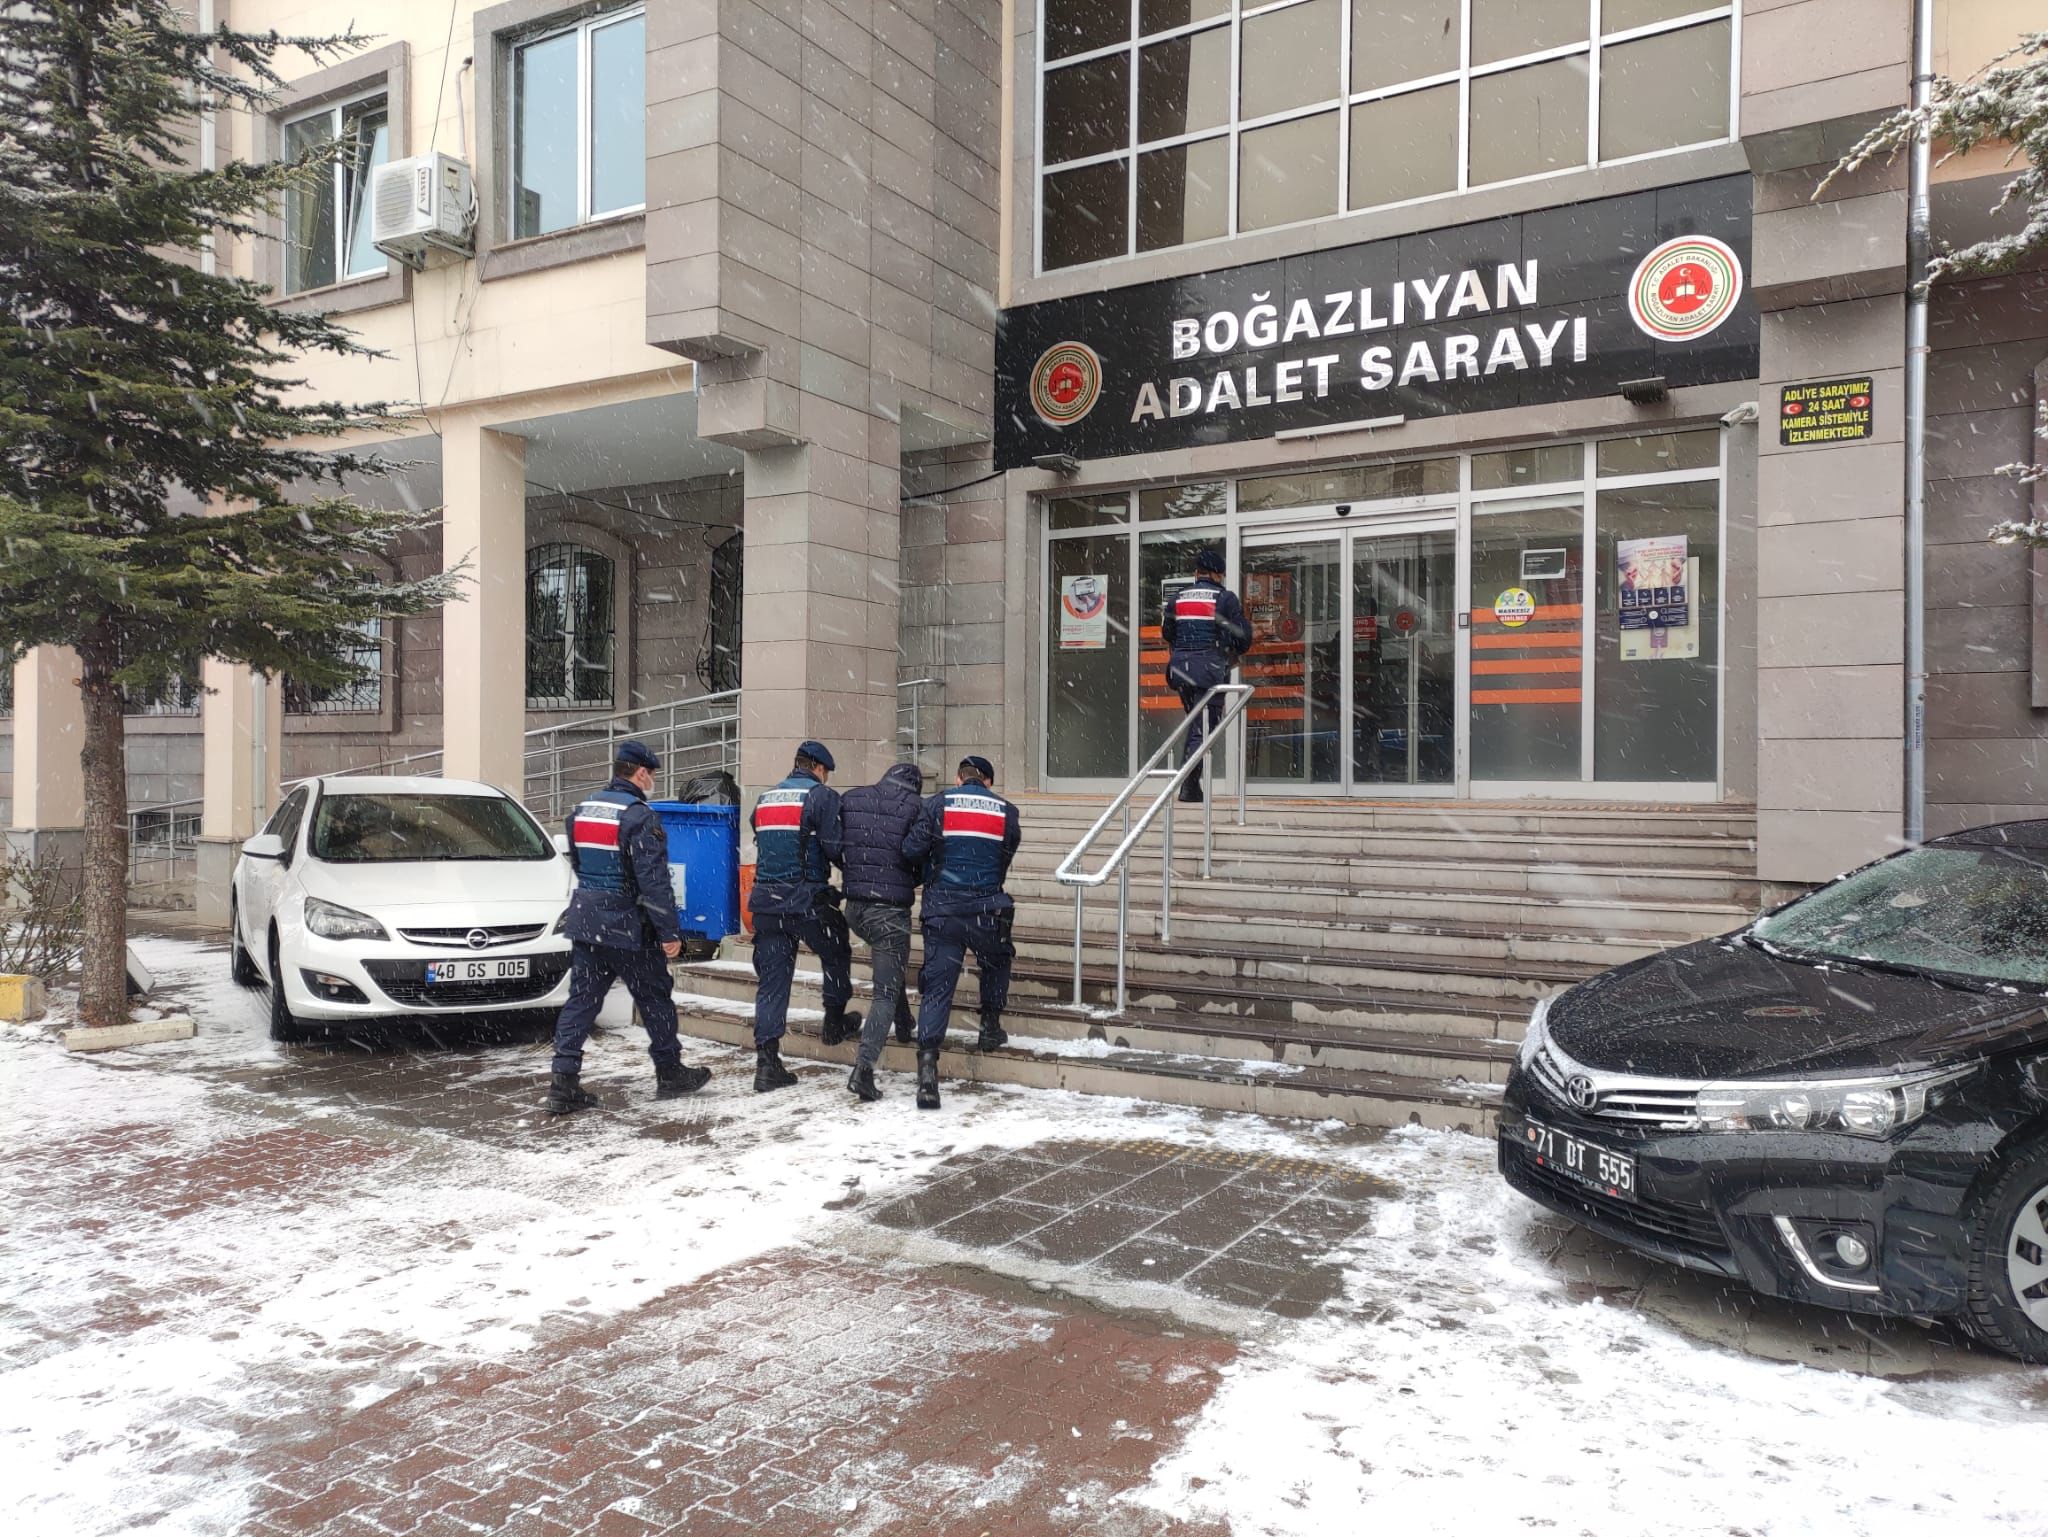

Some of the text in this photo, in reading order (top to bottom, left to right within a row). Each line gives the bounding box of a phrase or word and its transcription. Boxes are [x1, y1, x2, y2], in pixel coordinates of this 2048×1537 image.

[1660, 256, 1684, 276] ADALET
[1173, 258, 1539, 360] BOĞAZLIYAN
[1679, 307, 1706, 322] ADALET
[1131, 316, 1588, 424] ADALET SARAYI
[1784, 382, 1870, 401] ADLİYE SARAYIMIZ
[1808, 398, 1846, 412] 24 SAAT
[1782, 410, 1869, 430] KAMERA SİSTEMİYLE
[1789, 424, 1864, 443] İZLENMEKTEDİR
[951, 797, 1001, 812] JANDARMA
[436, 961, 525, 980] 48 GS 005
[1537, 1127, 1553, 1158] 71
[1599, 1154, 1632, 1190] 555
